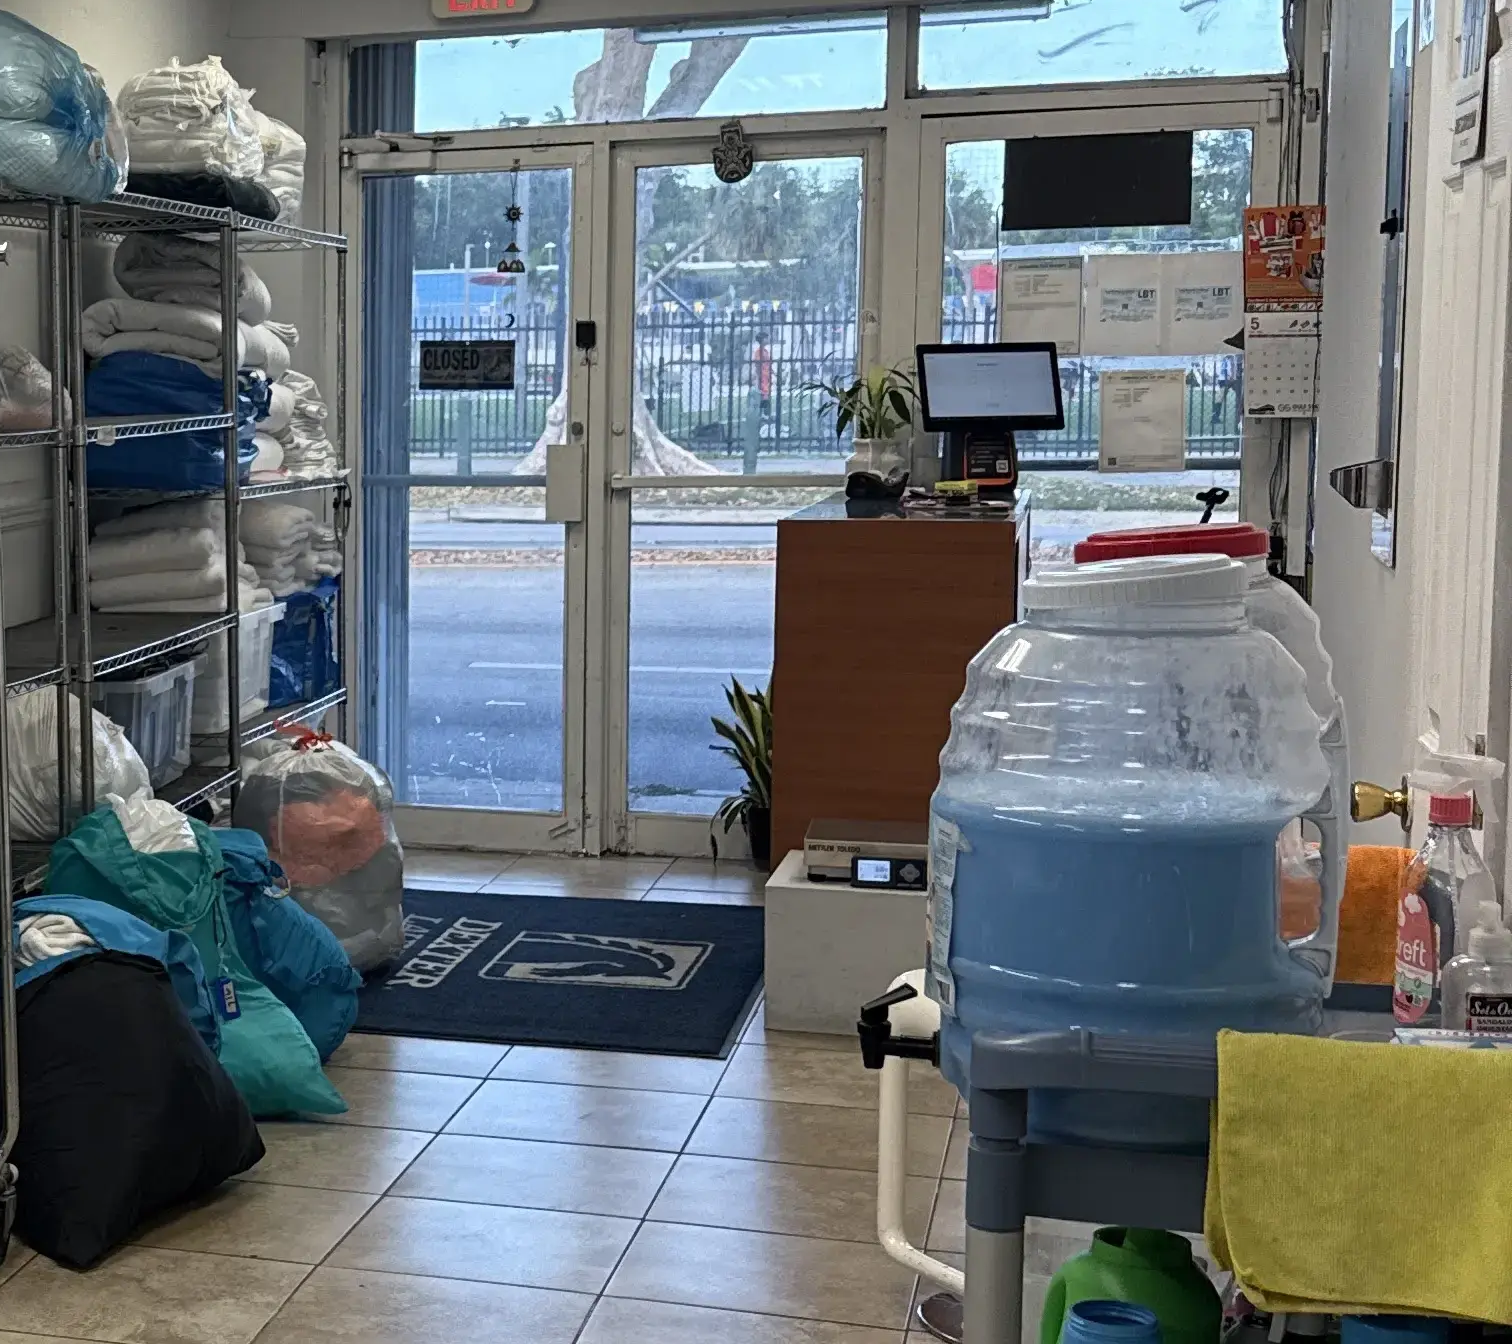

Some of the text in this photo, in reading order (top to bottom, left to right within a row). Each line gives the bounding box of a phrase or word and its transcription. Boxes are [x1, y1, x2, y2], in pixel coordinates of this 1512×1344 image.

[1138, 289, 1156, 298] LBT
[1212, 287, 1230, 297] LBT
[1250, 317, 1260, 331] 5
[423, 349, 480, 371] CLOSED
[837, 845, 861, 853] TOLEDO
[385, 917, 503, 988] DEXTER
[1398, 939, 1426, 967] reft
